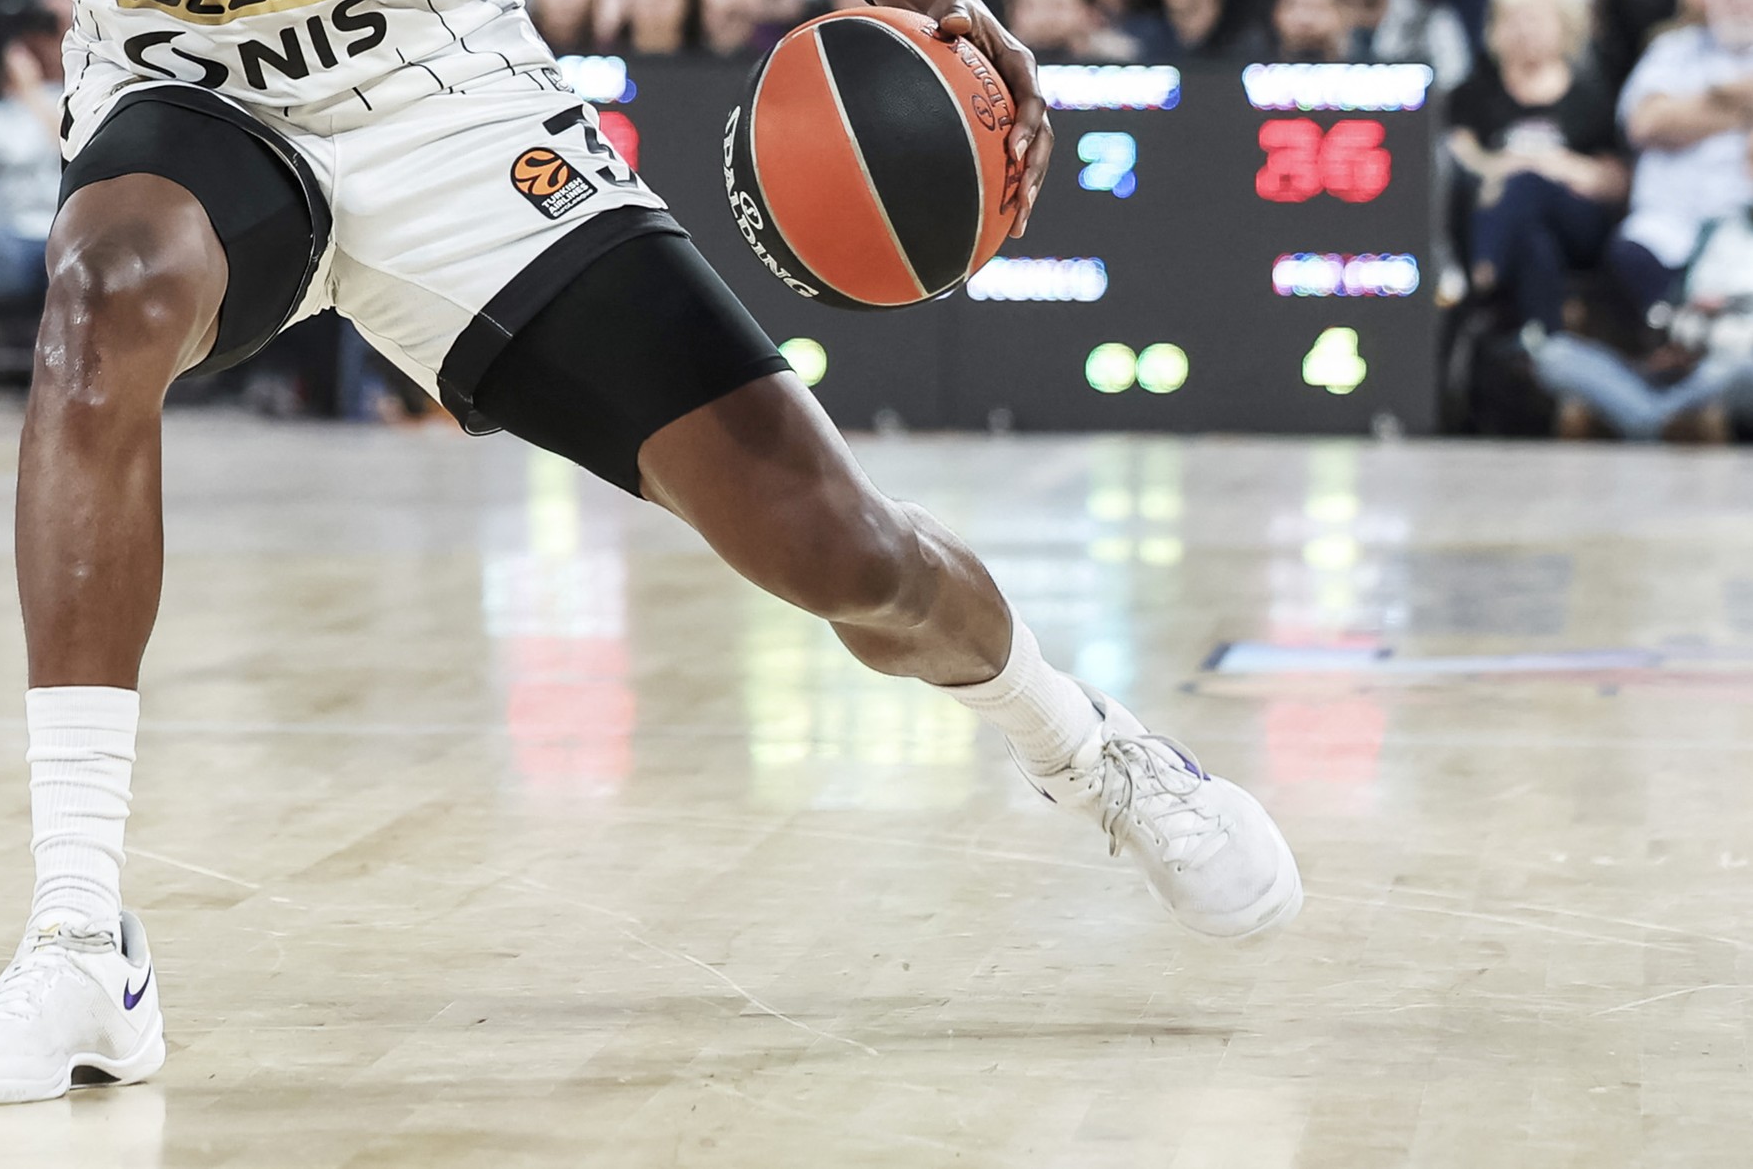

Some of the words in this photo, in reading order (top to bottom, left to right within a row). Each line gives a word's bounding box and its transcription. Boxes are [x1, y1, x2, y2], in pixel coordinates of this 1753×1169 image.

[541, 177, 583, 208] TURKISH
[548, 183, 589, 215] AIRLINES
[1302, 327, 1366, 394] 4
